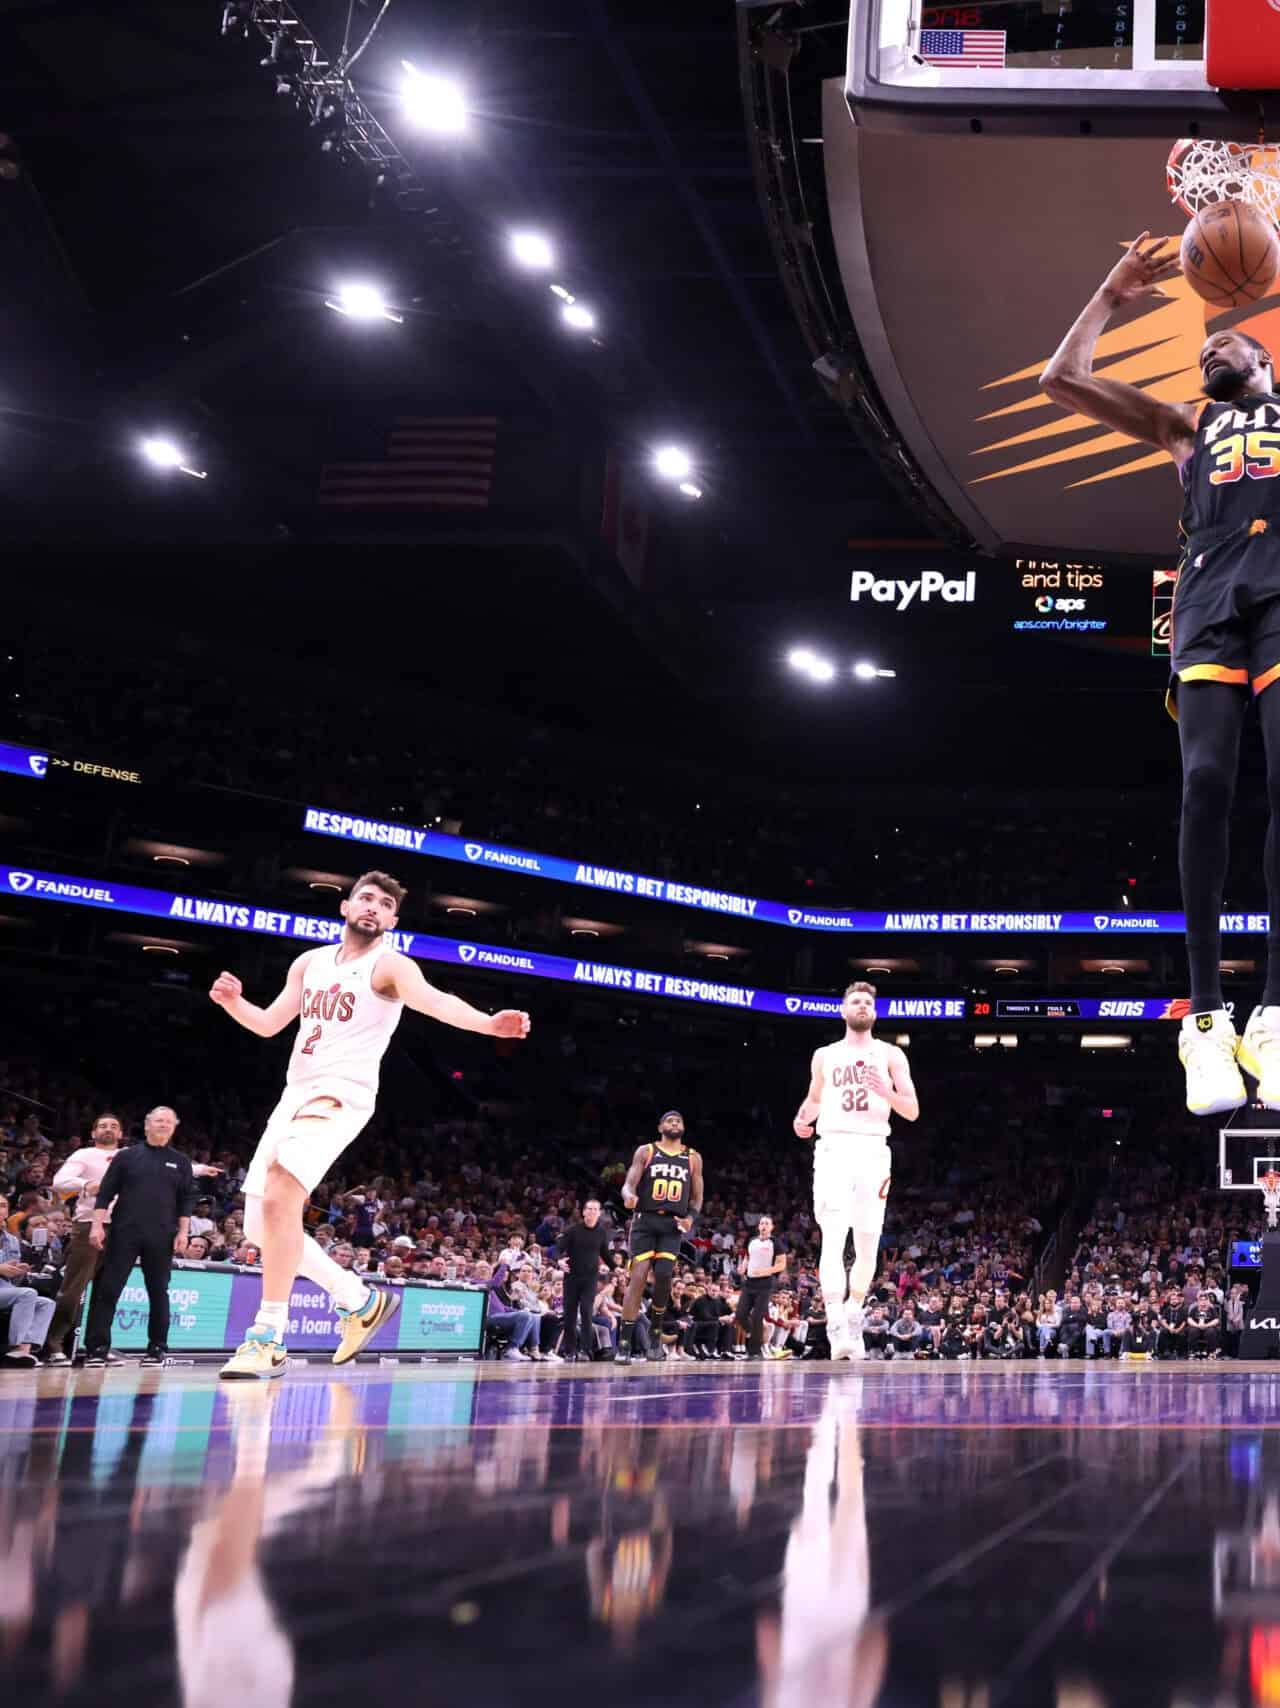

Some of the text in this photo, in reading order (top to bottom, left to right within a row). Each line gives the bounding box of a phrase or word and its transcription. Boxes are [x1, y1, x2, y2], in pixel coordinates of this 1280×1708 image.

[850, 570, 976, 611] PayPal
[1021, 570, 1103, 591] and tips
[1055, 598, 1087, 613] aps
[1013, 618, 1107, 631] aps.com/brighter
[305, 809, 426, 850] RESPONSIBLY
[484, 850, 541, 871] FANDUEL
[576, 865, 633, 893] ALWAYS
[636, 877, 664, 898] BET
[666, 883, 757, 916] RESPONSIBLY
[804, 914, 854, 928] FANDUEL
[885, 914, 939, 930] ALWAYS
[942, 914, 968, 930] BET
[971, 914, 1062, 930] RESPONSIBLY
[1111, 918, 1160, 929] FANDUEL
[1219, 915, 1244, 931] AYS
[35, 879, 965, 1017] FANDUEL ALWAYS BET RESPBLY FANDUEL ALWAYS BET RESPONSIBLY FANDU ALWAYS BE
[302, 983, 356, 1022] CAVS
[974, 1003, 990, 1015] 20
[301, 1024, 321, 1055] 2
[842, 1088, 869, 1112] 32
[650, 1164, 689, 1181] PHX
[652, 1179, 683, 1201] 00
[290, 1292, 326, 1308] meet
[301, 1315, 331, 1335] loan
